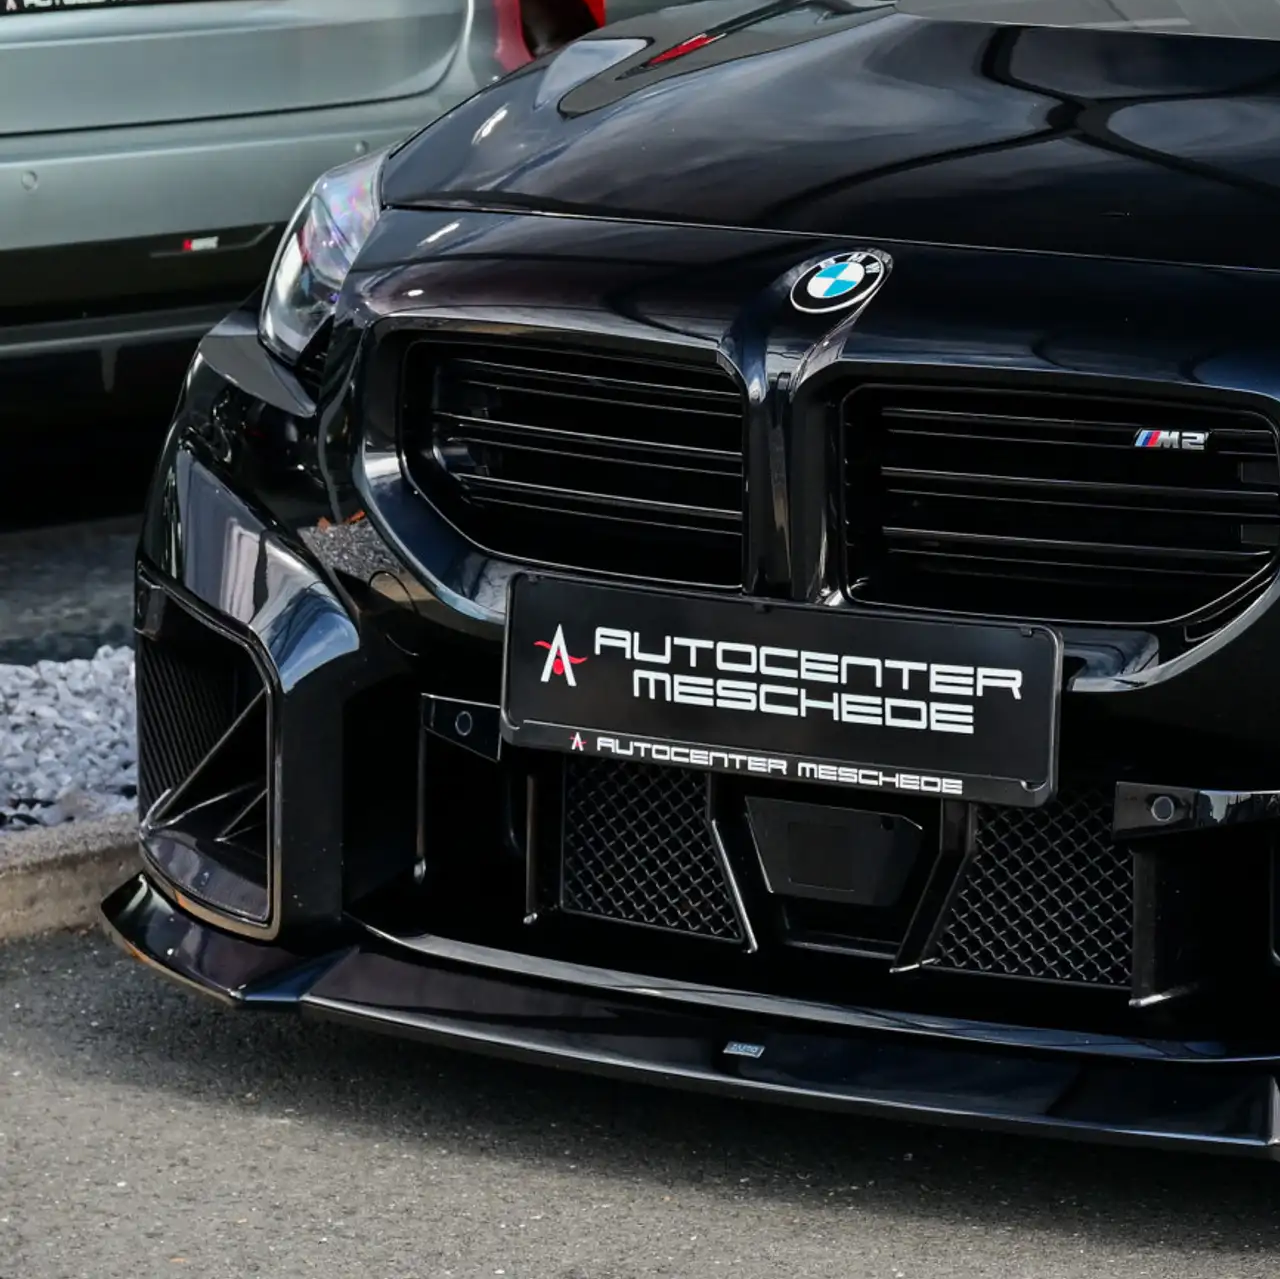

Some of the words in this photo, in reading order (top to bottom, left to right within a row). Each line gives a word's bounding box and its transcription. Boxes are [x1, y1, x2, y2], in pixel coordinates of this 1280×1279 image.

[1157, 429, 1206, 450] M2
[594, 626, 1024, 701] AUTOCENTER
[633, 669, 974, 735] MESCHEDE
[597, 736, 788, 776] AUTOCENTER
[797, 761, 963, 796] MESCHEDE
